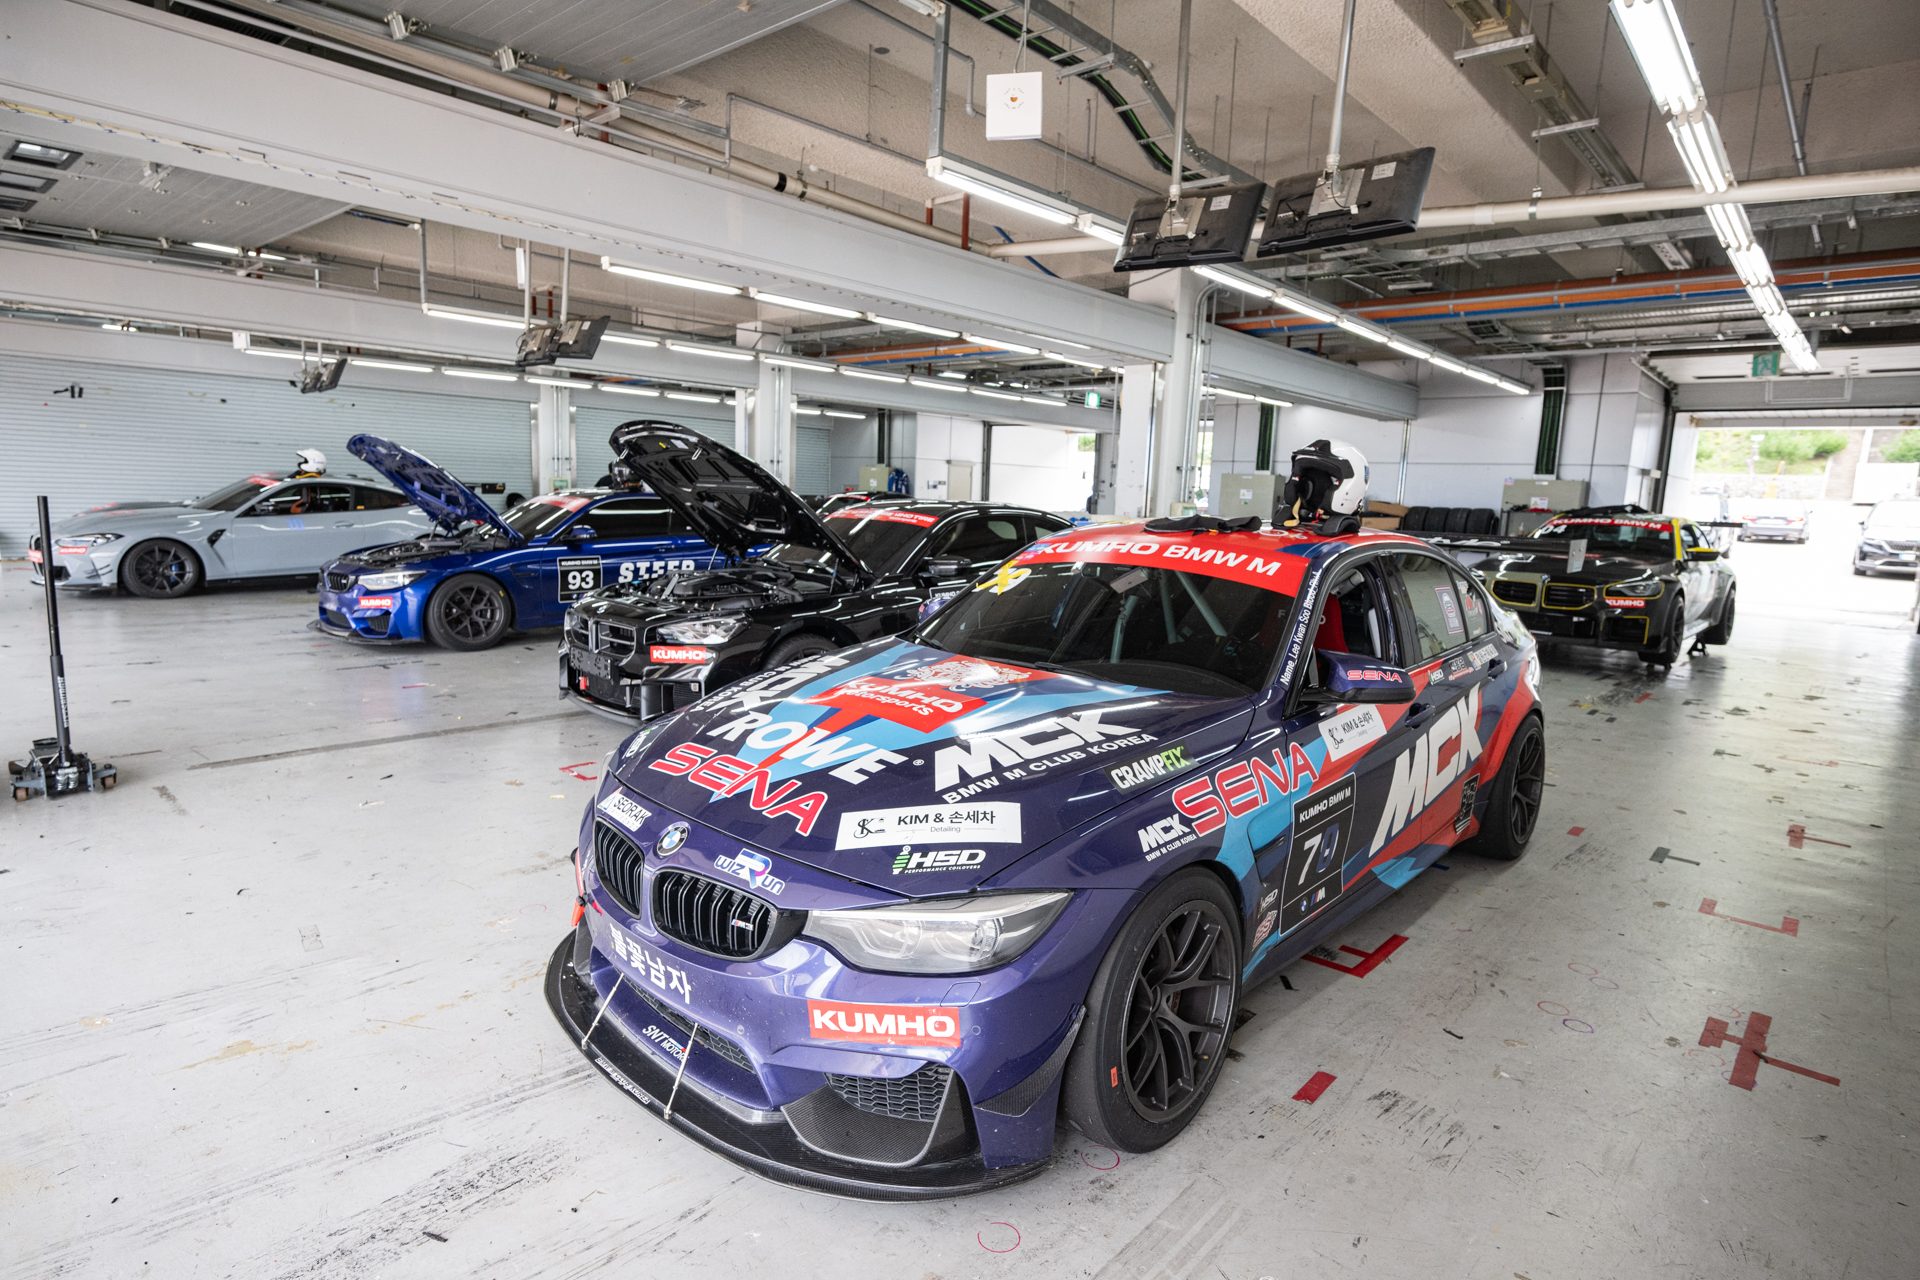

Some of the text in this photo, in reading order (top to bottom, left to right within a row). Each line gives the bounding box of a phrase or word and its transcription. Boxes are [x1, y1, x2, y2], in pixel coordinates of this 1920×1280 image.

[1040, 541, 1159, 555] KUMHO
[1163, 544, 1250, 568] BMW
[1248, 557, 1281, 576] M
[568, 570, 594, 590] 93
[1299, 608, 1311, 623] Soo
[1293, 624, 1306, 644] Kwan
[653, 650, 703, 660] KUMHO
[1347, 669, 1402, 683] SENA
[845, 681, 963, 713] KUMHO
[706, 711, 909, 785] ROWE
[935, 711, 1141, 792] MCK
[942, 734, 1158, 804] BMW M CLUB KOREA
[1111, 746, 1190, 789] CRAMPFIX
[1368, 682, 1483, 858] MCK
[648, 742, 828, 837] SENA
[1172, 742, 1319, 837] SENA
[1300, 786, 1351, 823] KUMHO BMW M
[613, 797, 648, 824] SEORAK
[898, 810, 996, 826] KIM & 손세차
[930, 825, 961, 833] Detailing
[1138, 813, 1191, 853] MCK
[908, 849, 987, 868] HSD
[609, 922, 692, 1005] 불꽃남자
[642, 1025, 669, 1045] SNT
[812, 1009, 956, 1038] KUMHO
